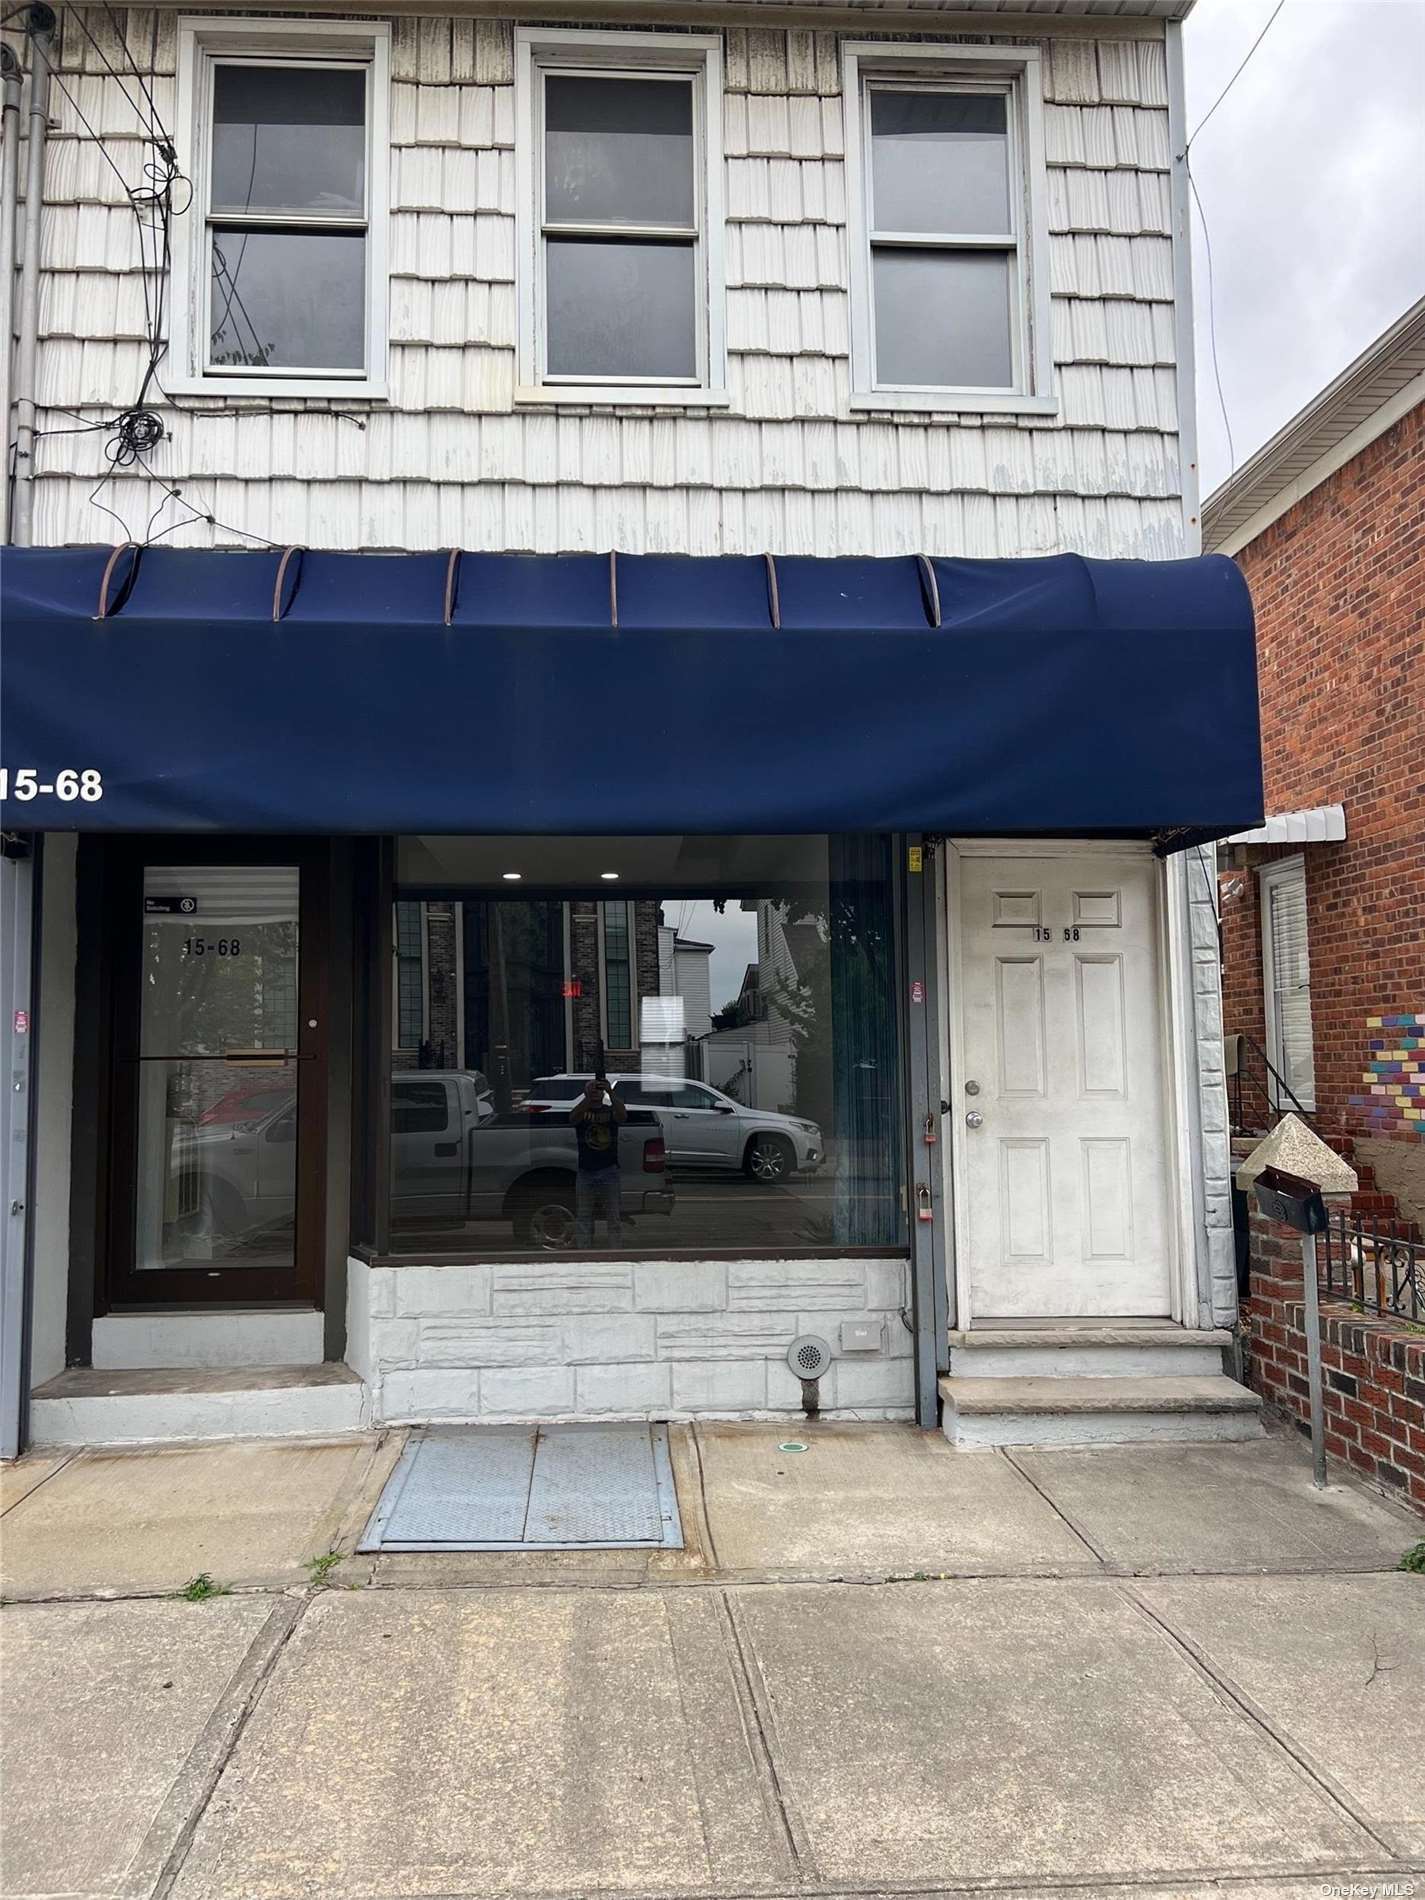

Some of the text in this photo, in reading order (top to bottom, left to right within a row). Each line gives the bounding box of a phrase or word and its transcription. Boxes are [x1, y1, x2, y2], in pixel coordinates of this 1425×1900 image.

[0, 768, 103, 801] 15-68
[1035, 928, 1080, 941] 15 68
[184, 939, 240, 956] 15-68
